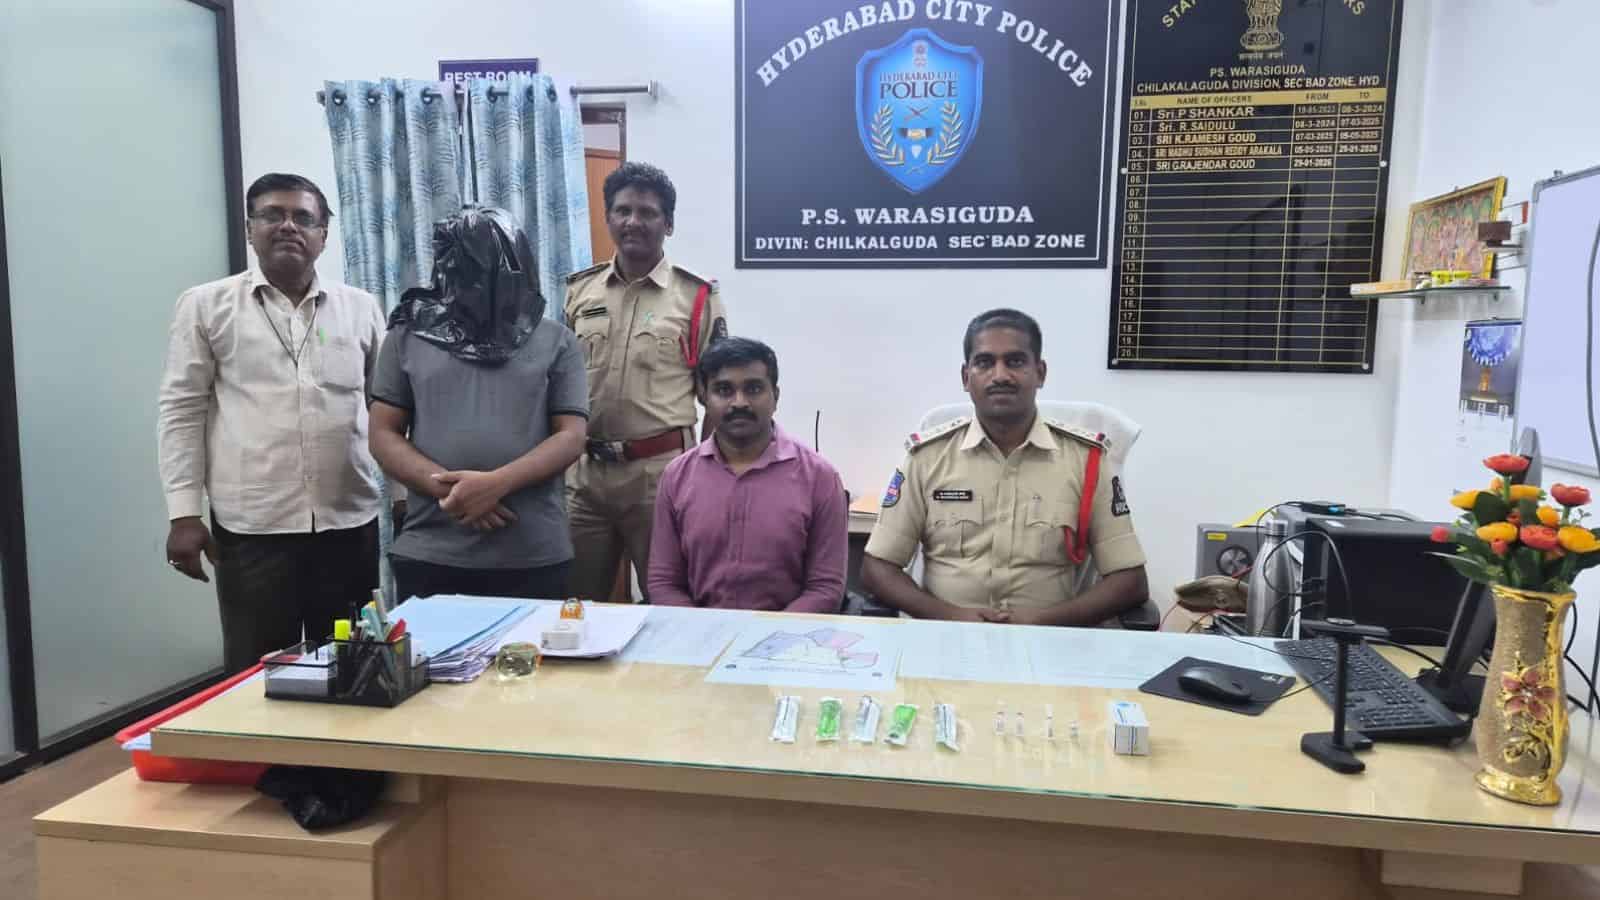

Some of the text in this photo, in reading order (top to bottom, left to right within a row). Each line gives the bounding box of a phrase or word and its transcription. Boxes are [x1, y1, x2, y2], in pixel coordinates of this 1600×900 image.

[756, 0, 1093, 87] HYDERABAD CITY POLICE
[1230, 64, 1306, 77] WARASIGUDA
[880, 80, 958, 99] POLICE
[1136, 80, 1229, 93] CHILAKALAGUDA
[1359, 75, 1380, 86] HYD
[1176, 97, 1199, 105] NAME
[1201, 96, 1211, 104] OF
[1305, 92, 1329, 100] FROM
[1189, 106, 1255, 118] SHANKAR
[1156, 134, 1172, 145] SRI
[1227, 133, 1256, 143] GOUD
[1156, 160, 1171, 171] SRI
[1229, 159, 1256, 169] GOUD
[801, 205, 1034, 225] P.S. WARASIGUDA
[755, 236, 809, 250] DIVIN:
[814, 235, 938, 250] CHILKALGUDA
[1034, 233, 1087, 249] ZONE
